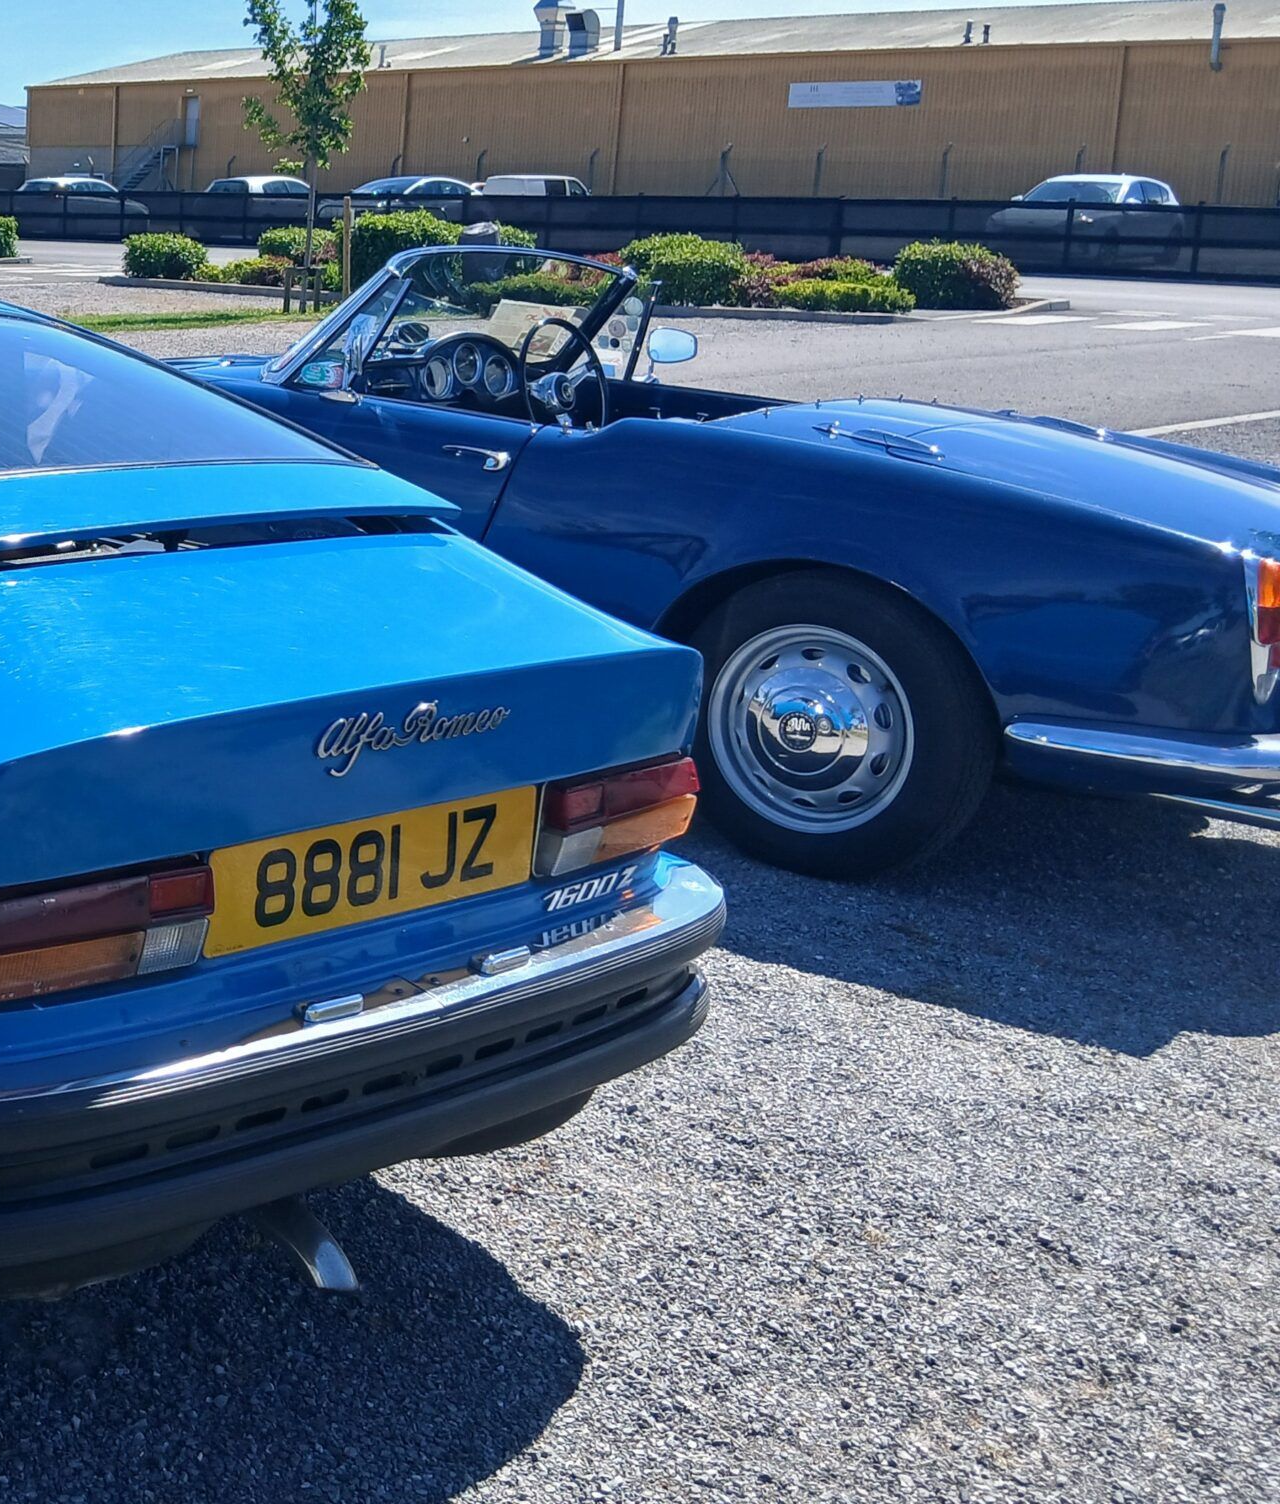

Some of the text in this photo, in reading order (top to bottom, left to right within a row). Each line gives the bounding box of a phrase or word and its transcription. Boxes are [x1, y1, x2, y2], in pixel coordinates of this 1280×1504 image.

[317, 700, 511, 777] Alfa Romeo
[254, 803, 497, 928] 8881 JZ
[543, 872, 619, 912] 1600
